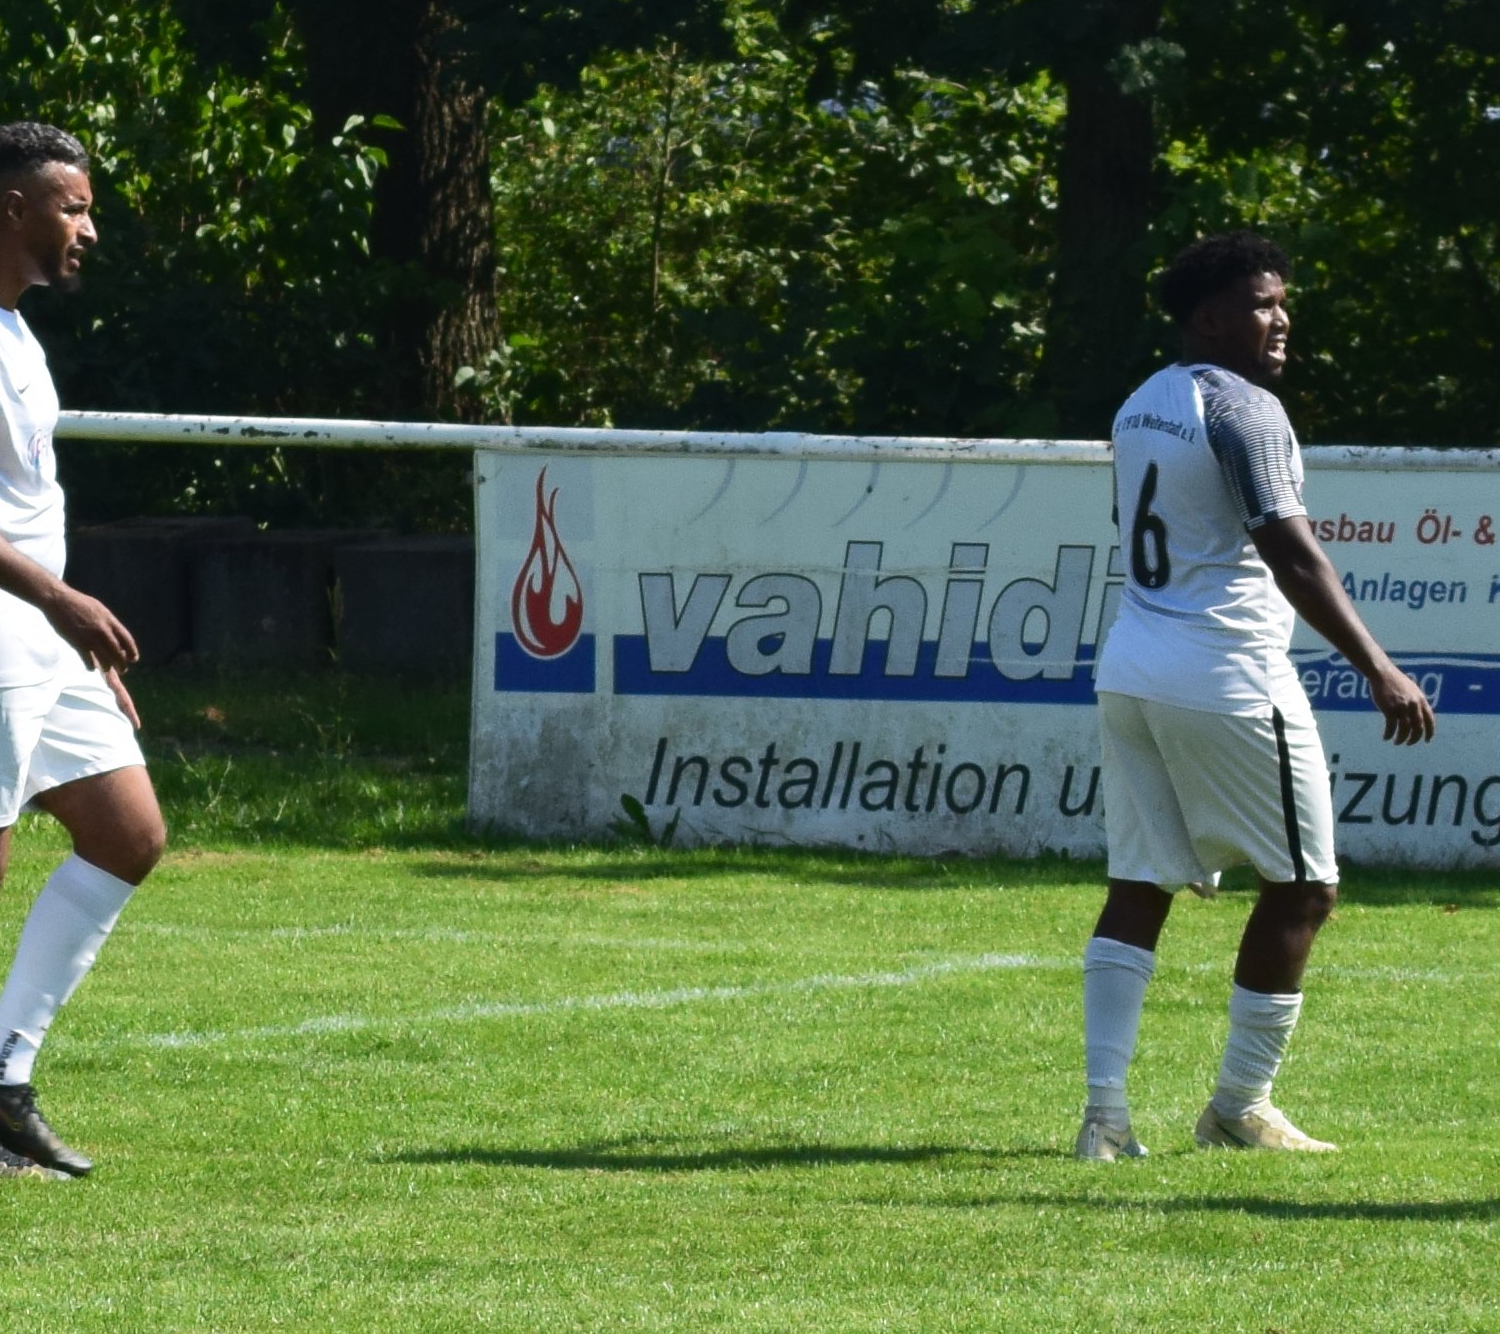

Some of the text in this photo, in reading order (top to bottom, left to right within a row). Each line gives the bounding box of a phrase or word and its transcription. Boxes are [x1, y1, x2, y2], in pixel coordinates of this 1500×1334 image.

[1131, 459, 1172, 591] 6
[1309, 513, 1395, 544] sbau
[1415, 507, 1462, 545] Öl-
[1473, 514, 1496, 546] &
[1340, 570, 1467, 610] Anlagen
[644, 736, 1031, 816] Installation
